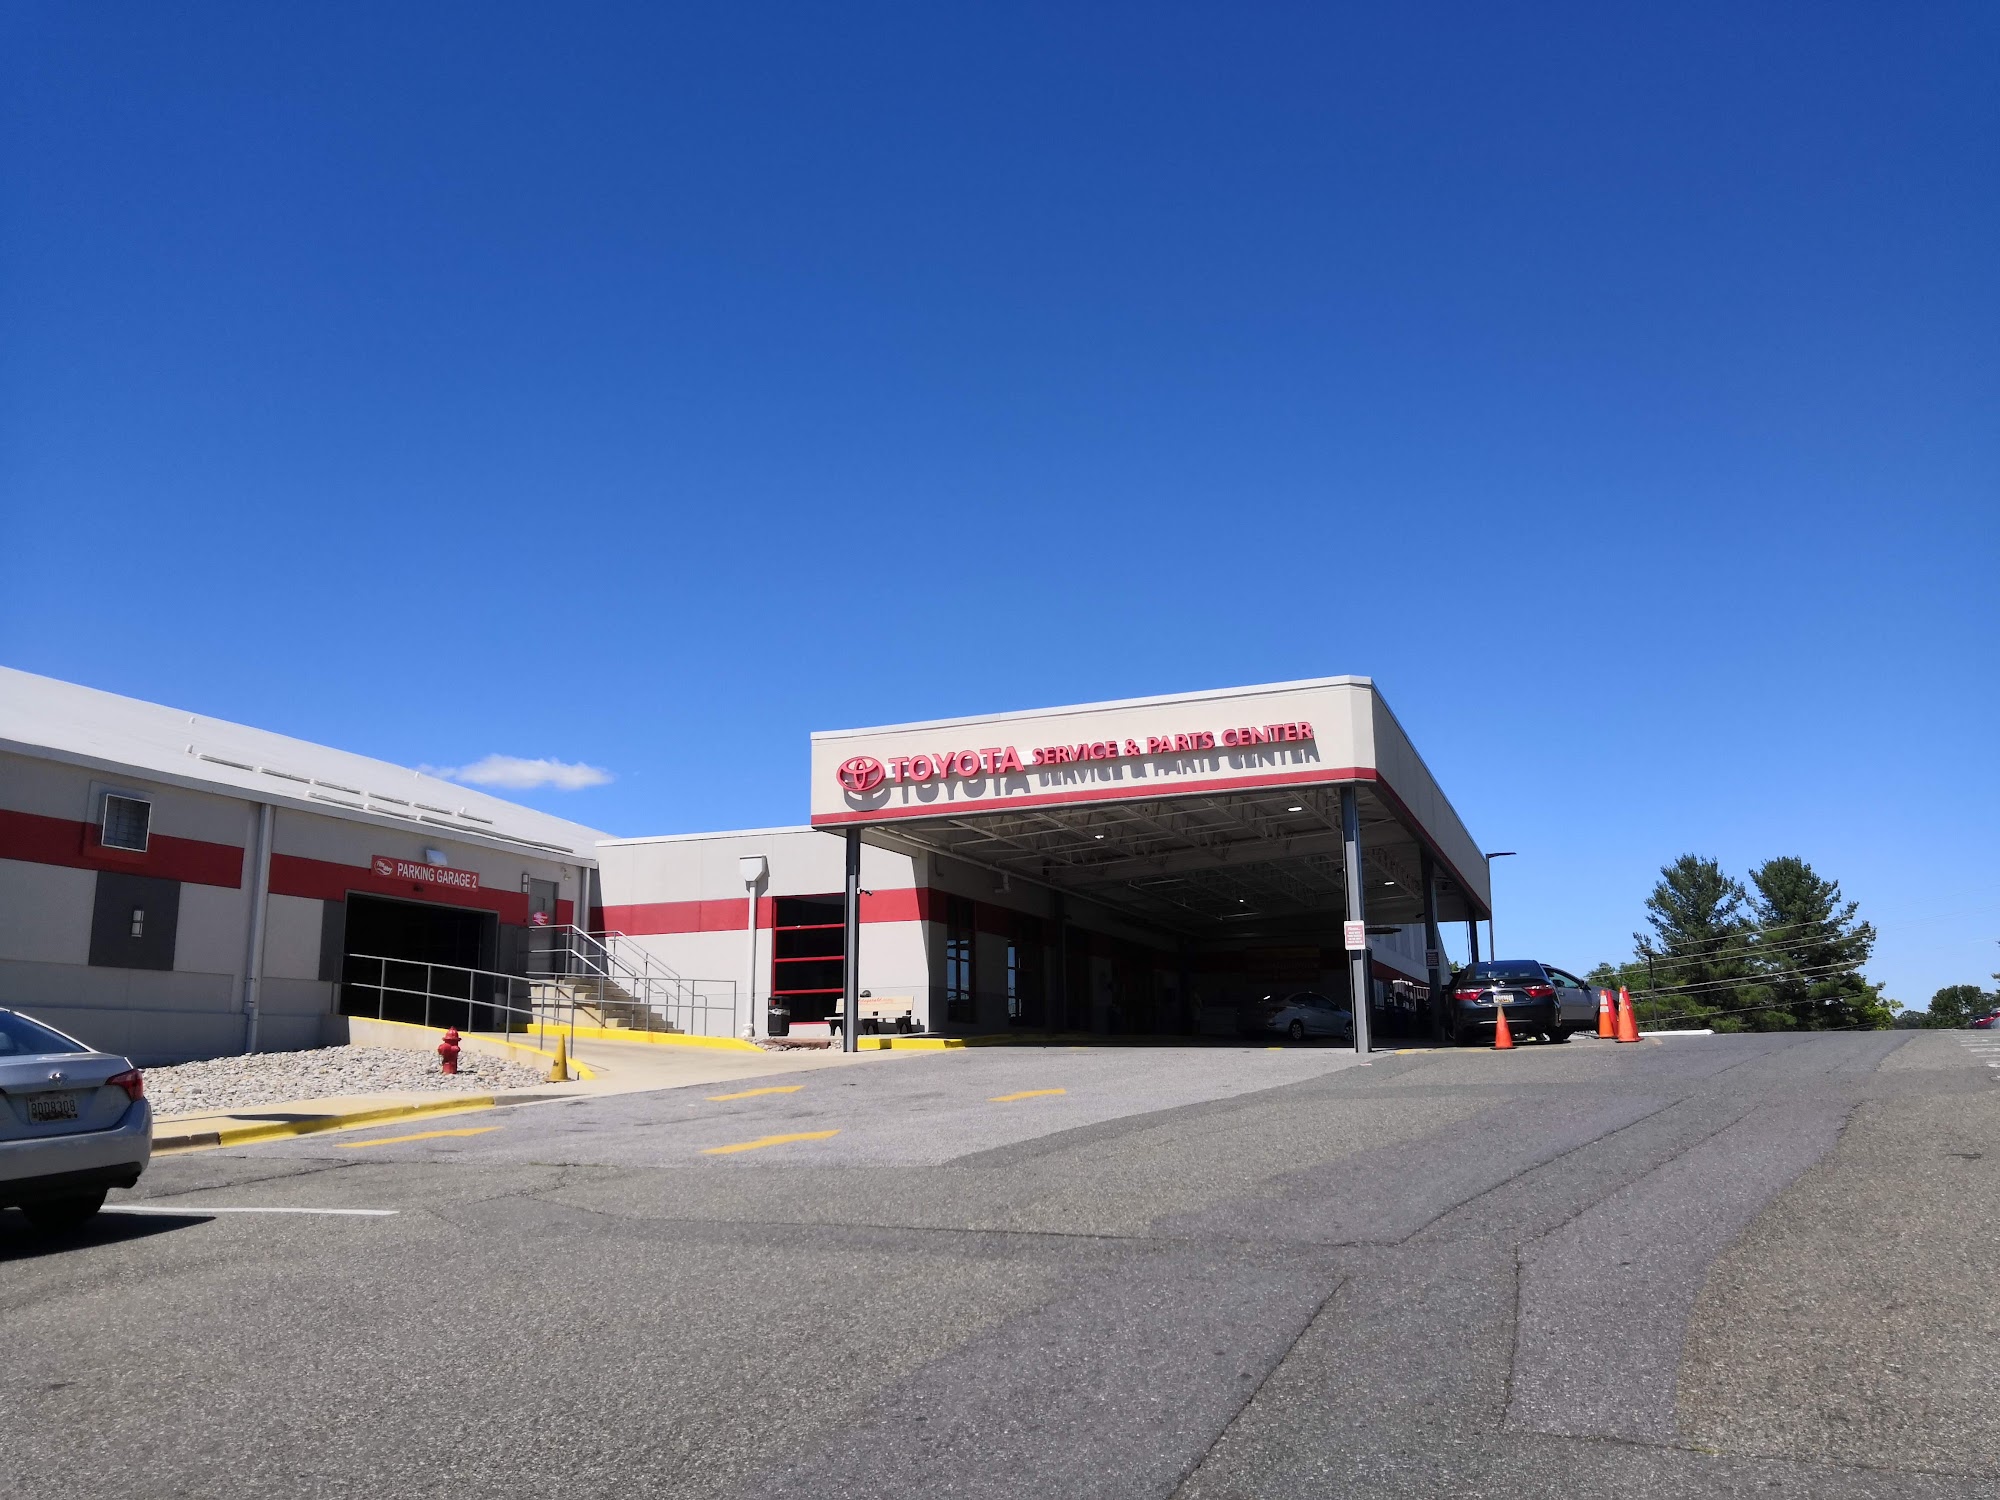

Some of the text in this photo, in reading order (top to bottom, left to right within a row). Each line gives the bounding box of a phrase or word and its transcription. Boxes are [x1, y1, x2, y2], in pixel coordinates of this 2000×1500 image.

[888, 722, 1314, 783] TOYOTA SERVICE & PARTS CENTER
[397, 862, 435, 882] PARKING
[436, 869, 471, 887] GARAGE
[471, 875, 477, 889] 2
